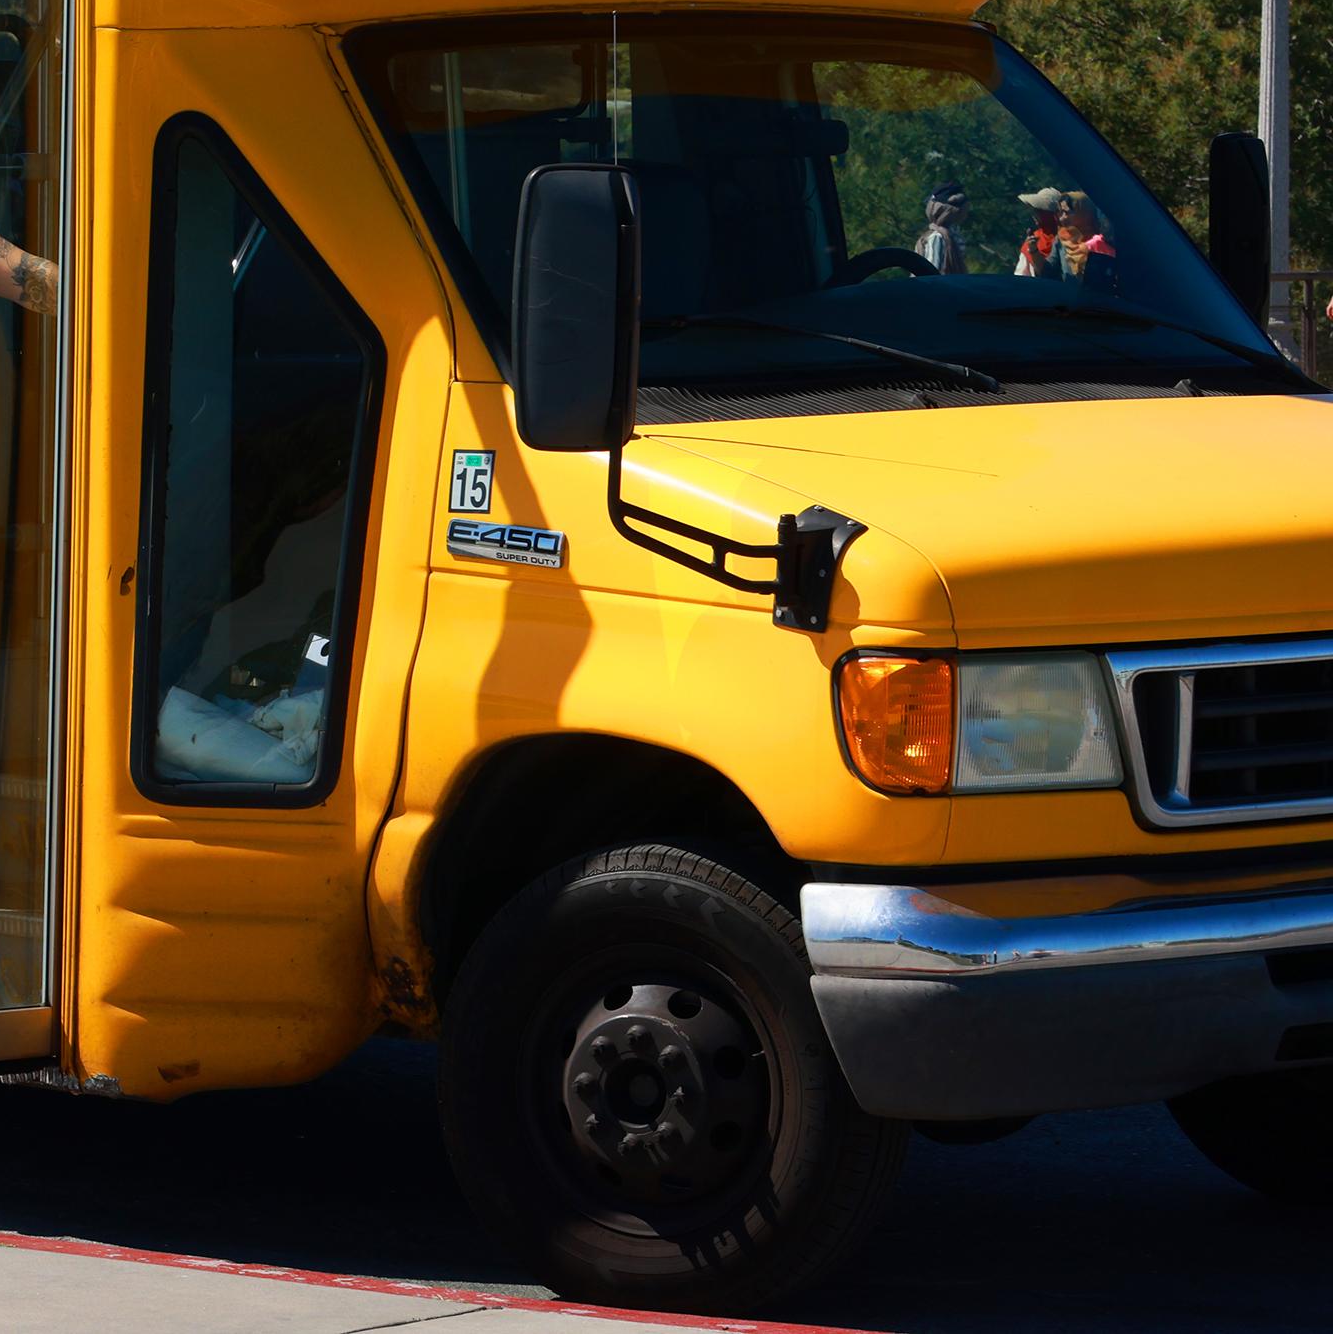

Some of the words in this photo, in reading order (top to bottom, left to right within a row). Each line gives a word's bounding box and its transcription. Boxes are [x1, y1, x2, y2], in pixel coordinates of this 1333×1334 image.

[456, 468, 488, 508] 15
[448, 521, 559, 555] E-450
[496, 551, 528, 563] SUPER
[530, 556, 557, 567] DUTY
